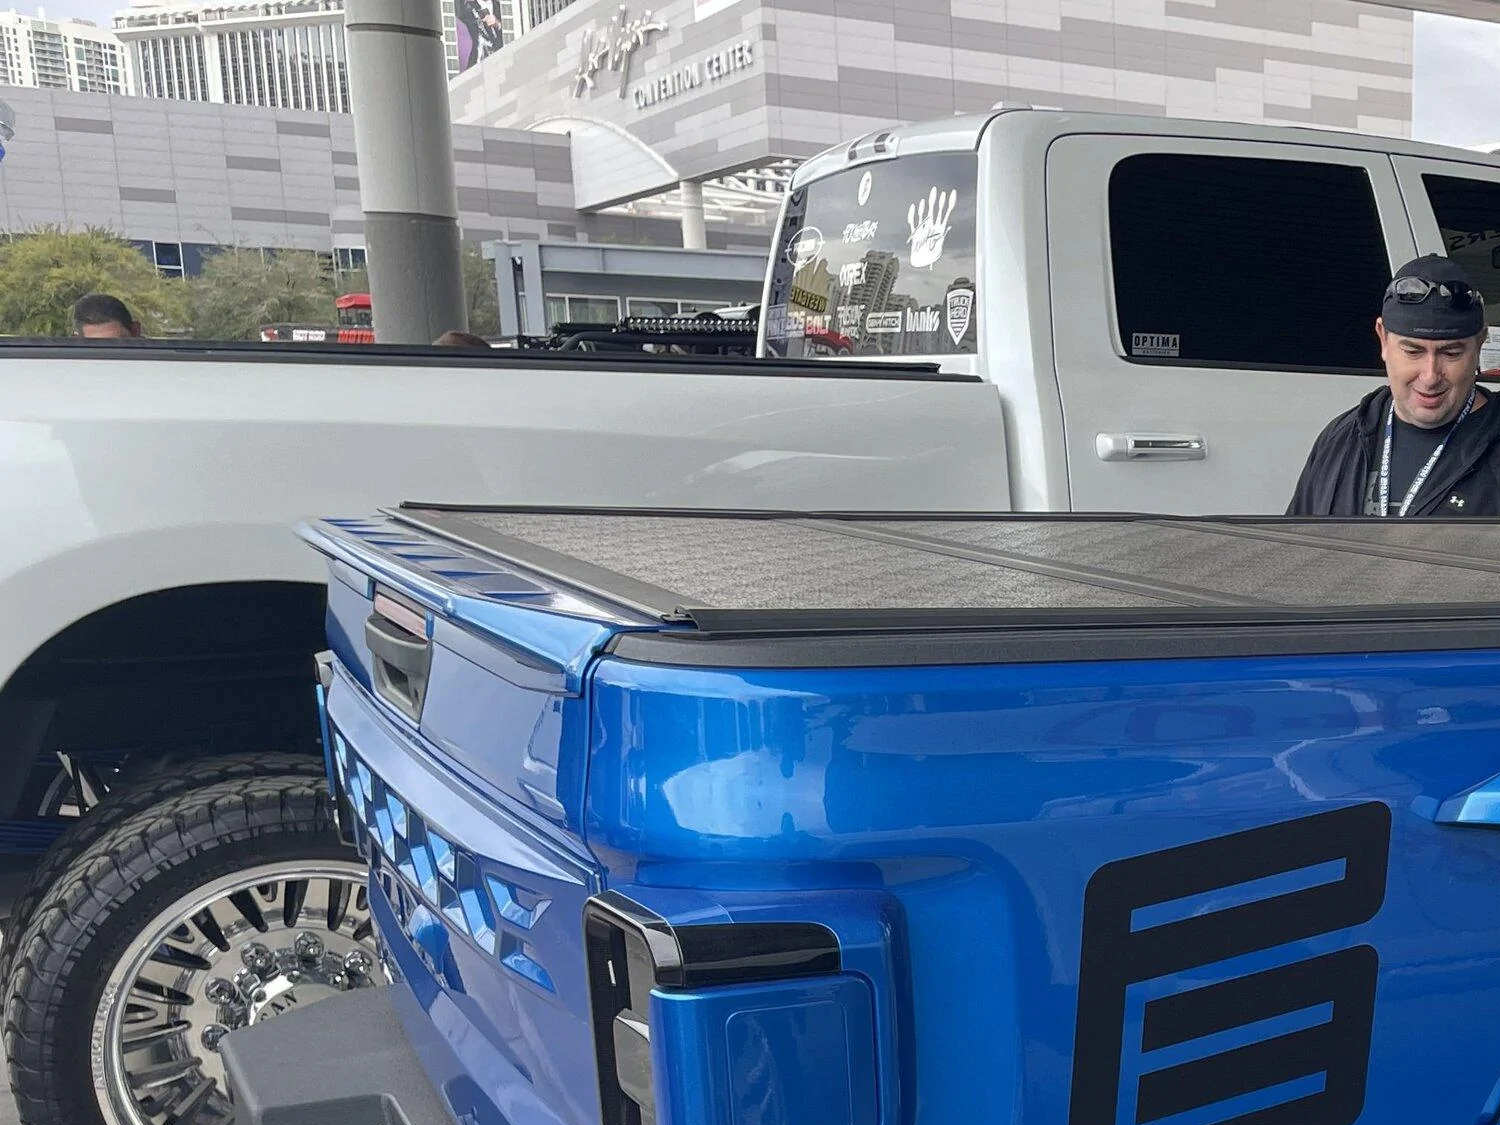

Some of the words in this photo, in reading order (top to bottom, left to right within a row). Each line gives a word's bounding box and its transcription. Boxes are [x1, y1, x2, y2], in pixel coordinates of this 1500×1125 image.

[633, 62, 701, 110] CONVENTION
[705, 39, 753, 81] CENTER
[805, 314, 832, 335] BOLT
[905, 306, 941, 332] banks
[1134, 335, 1178, 348] OPTIMA
